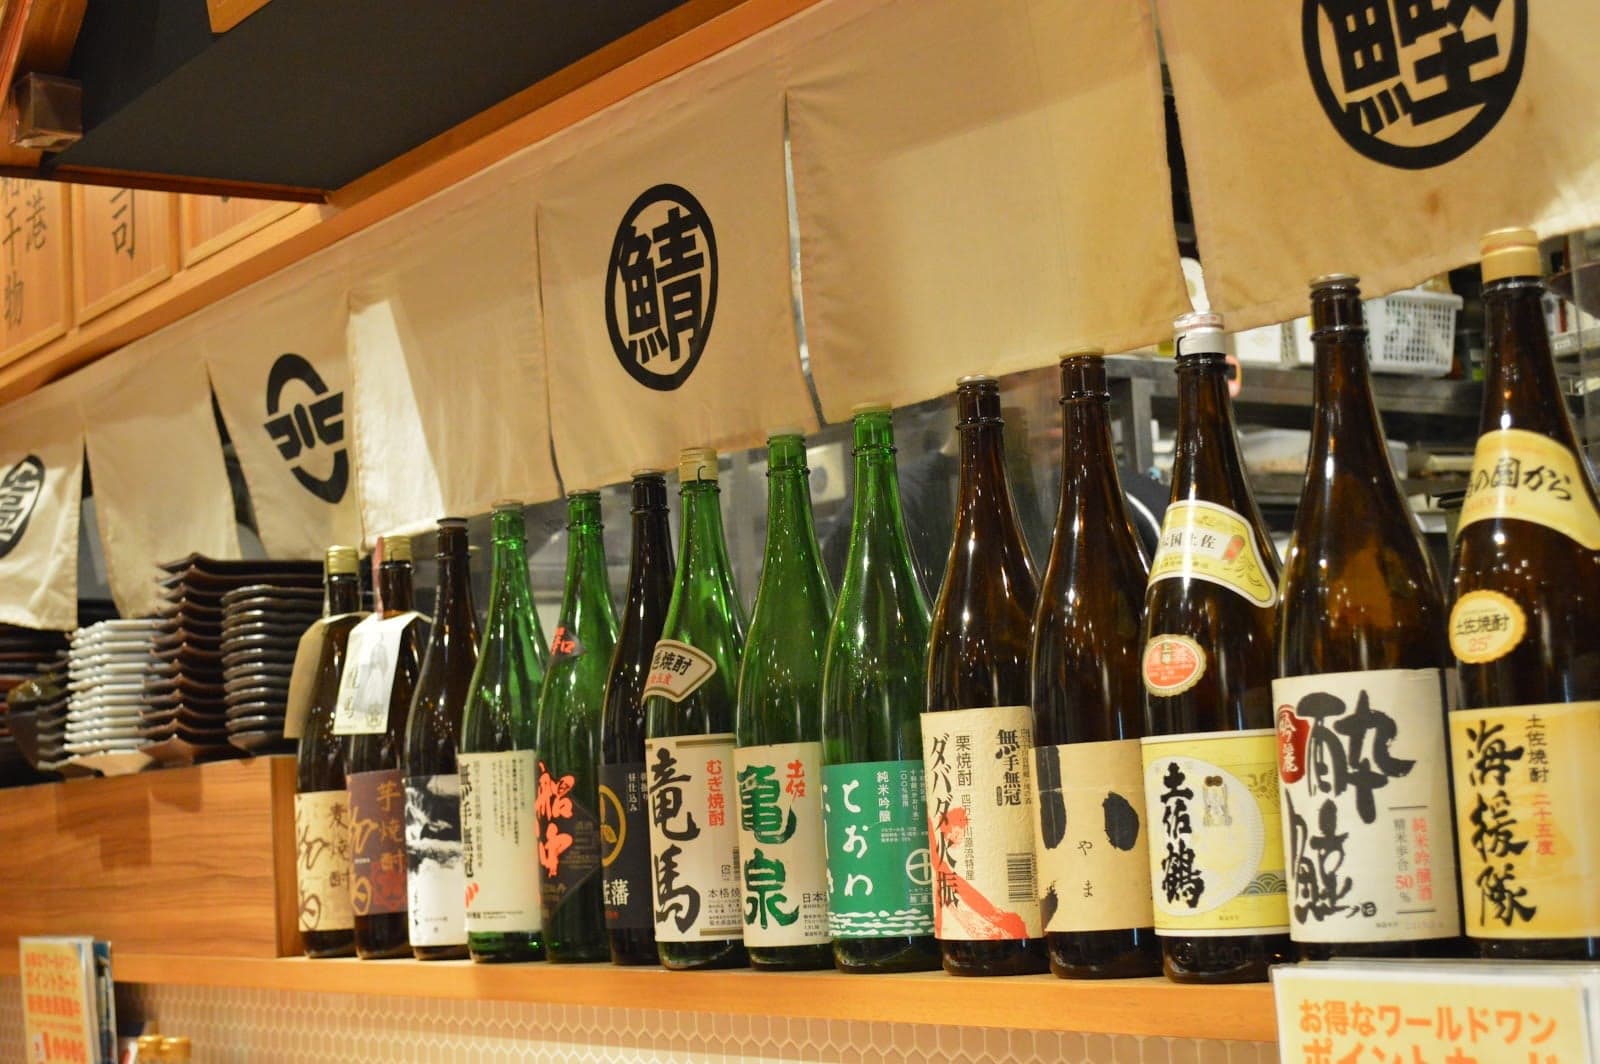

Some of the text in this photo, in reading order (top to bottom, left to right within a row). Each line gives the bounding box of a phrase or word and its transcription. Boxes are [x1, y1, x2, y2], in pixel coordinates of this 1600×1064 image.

[785, 759, 807, 801] 土佐
[955, 735, 973, 787] 栗焼酎
[1525, 714, 1550, 783] 土佐焼酎
[706, 759, 725, 827] むぎ焼酎
[876, 770, 892, 823] 純米吟醸
[931, 732, 960, 909] ダバダ火振
[1466, 719, 1538, 928] 海援隊
[1532, 793, 1555, 857] 二十五度
[650, 747, 701, 935] 竜馬
[736, 764, 800, 931] 亀泉
[842, 779, 874, 897] とおわ
[1160, 761, 1206, 910] 土佐鶴
[802, 890, 829, 905] 日本
[1298, 999, 1558, 1044] お得なワールドワン
